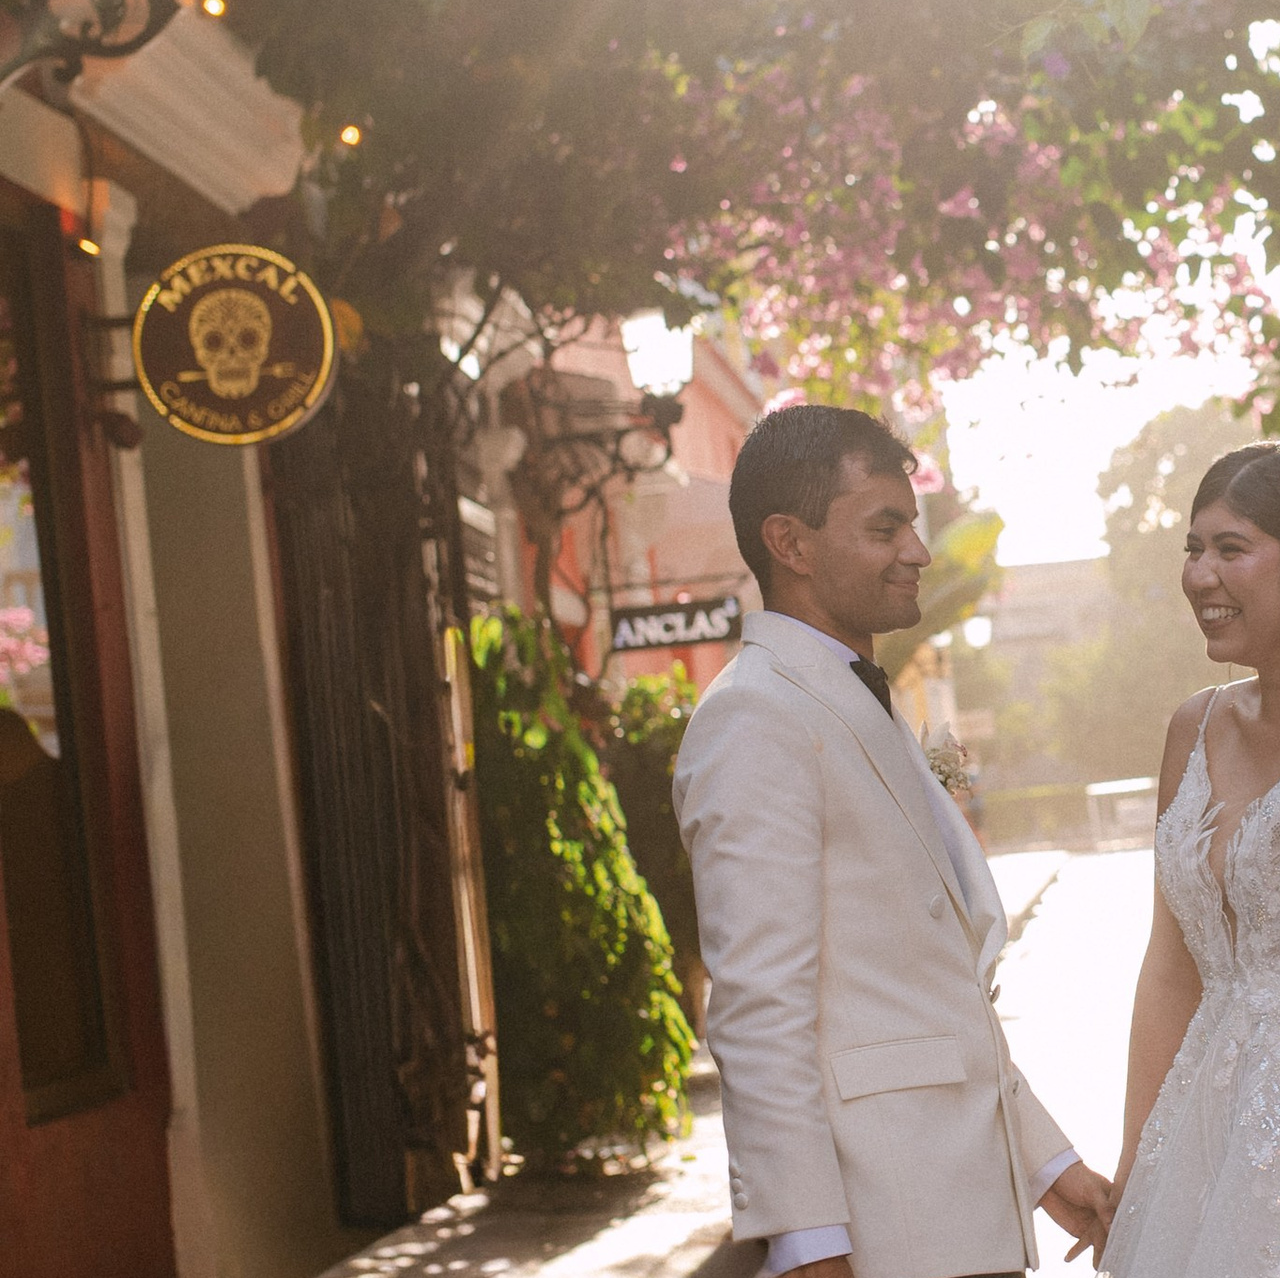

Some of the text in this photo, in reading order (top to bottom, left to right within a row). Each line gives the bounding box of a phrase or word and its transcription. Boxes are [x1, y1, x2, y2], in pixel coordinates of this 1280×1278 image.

[157, 256, 298, 313] MEXCAL
[160, 381, 243, 432] CANTINA
[246, 408, 264, 430] &
[614, 607, 731, 649] ANCLAS
